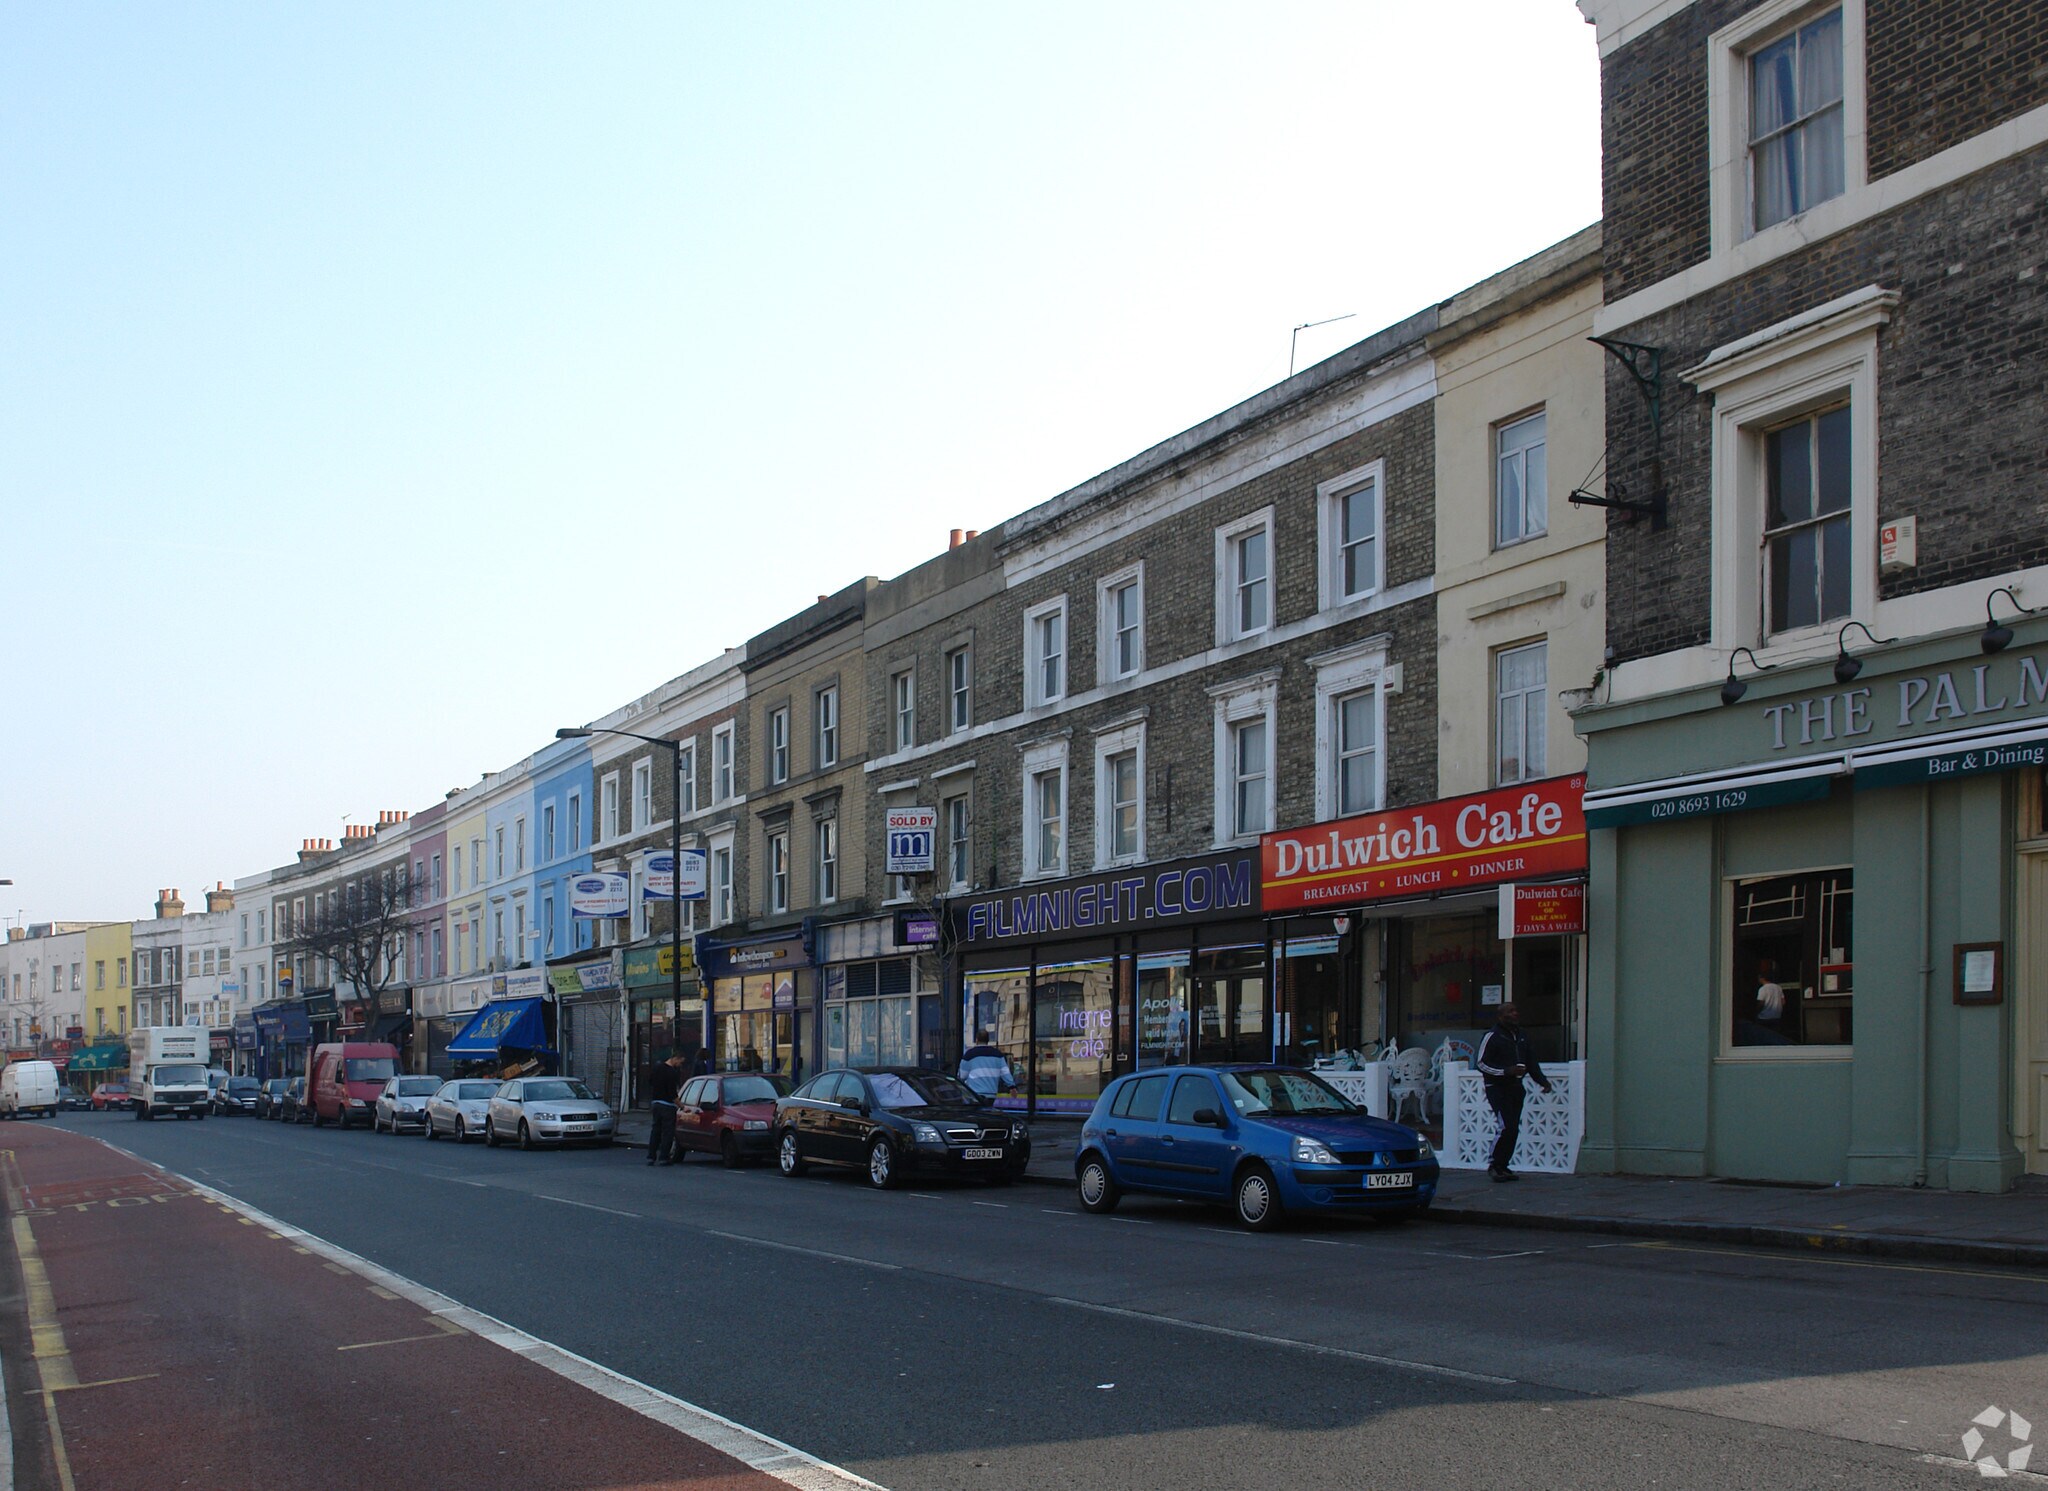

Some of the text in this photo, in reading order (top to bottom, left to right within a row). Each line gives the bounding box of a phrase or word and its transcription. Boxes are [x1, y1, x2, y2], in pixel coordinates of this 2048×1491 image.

[1764, 687, 1874, 749] THE
[1928, 745, 2045, 775] Bar & Dining
[1570, 778, 1582, 790] 89
[1651, 790, 1747, 818] 020 8693 1629
[889, 816, 934, 827] SOLD BY
[1274, 792, 1563, 879] Dulwich Cafe
[1303, 858, 1526, 900] BREAKFAST LUNCH DINNER
[1516, 887, 1582, 899] Dulwich Cafe
[967, 859, 1252, 943] FILMNIGHT.COM
[1516, 925, 1521, 933] 7
[1523, 924, 1545, 932] DAYS
[1555, 922, 1580, 930] WEEK
[1071, 1029, 1104, 1058] café
[1369, 1174, 1411, 1186] LY04 ZJX
